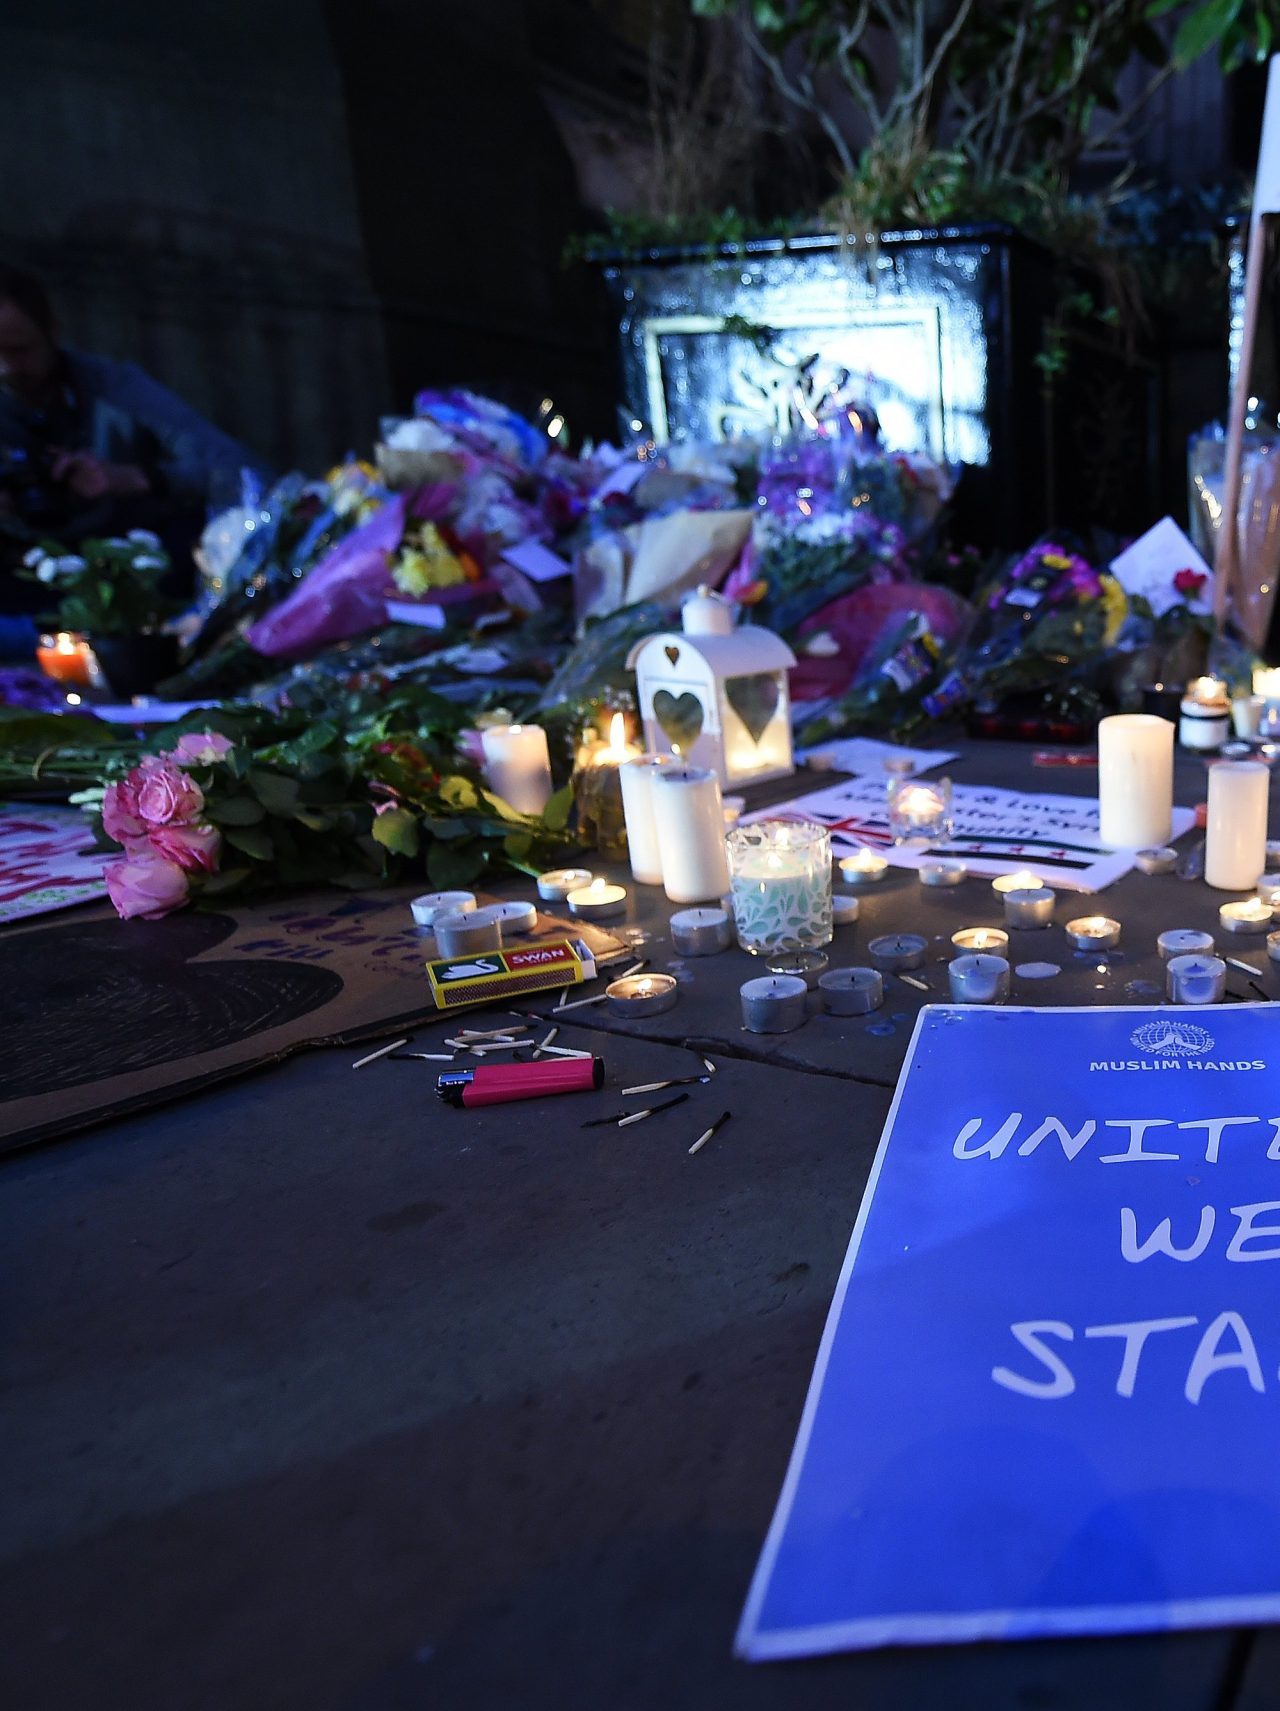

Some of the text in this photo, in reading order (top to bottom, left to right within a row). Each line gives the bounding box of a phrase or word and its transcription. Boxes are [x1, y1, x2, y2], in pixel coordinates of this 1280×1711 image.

[511, 948, 565, 965] SWAN
[1089, 1060, 1266, 1072] MUSLIM HANDS
